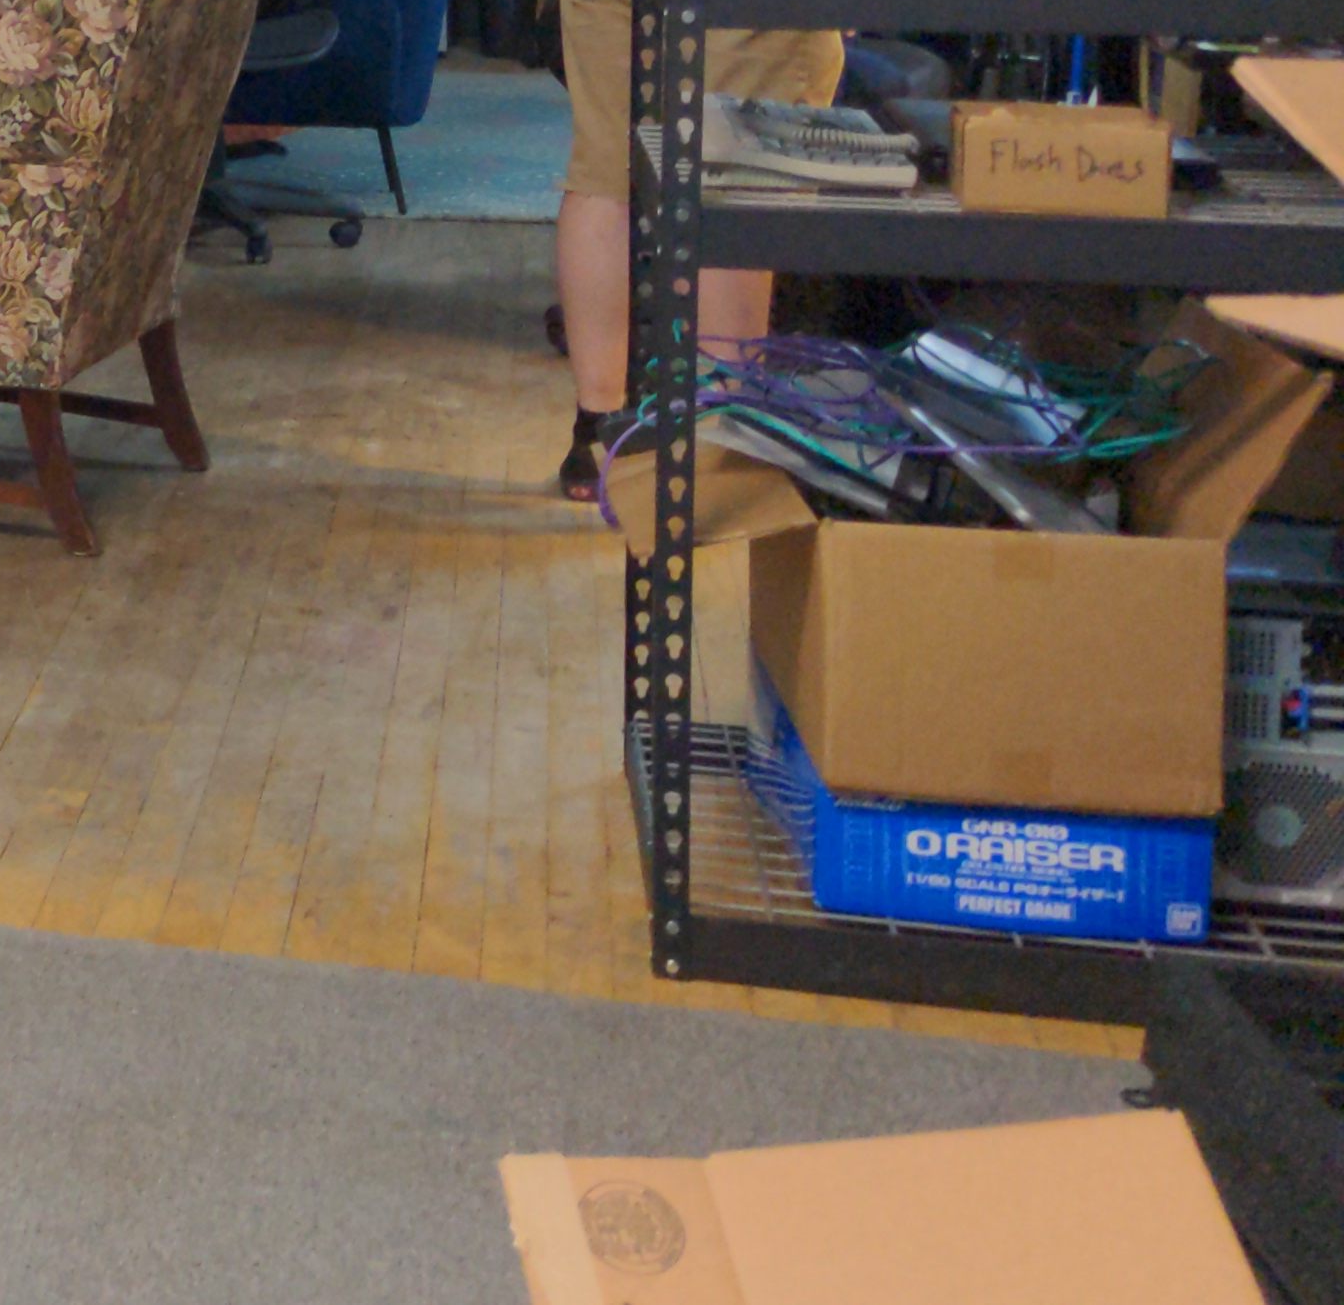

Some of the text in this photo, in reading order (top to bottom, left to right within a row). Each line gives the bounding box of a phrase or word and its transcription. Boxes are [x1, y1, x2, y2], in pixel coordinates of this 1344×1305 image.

[990, 138, 1062, 174] Flash
[945, 832, 1126, 873] RAISER
[959, 895, 1022, 915] PERFECT
